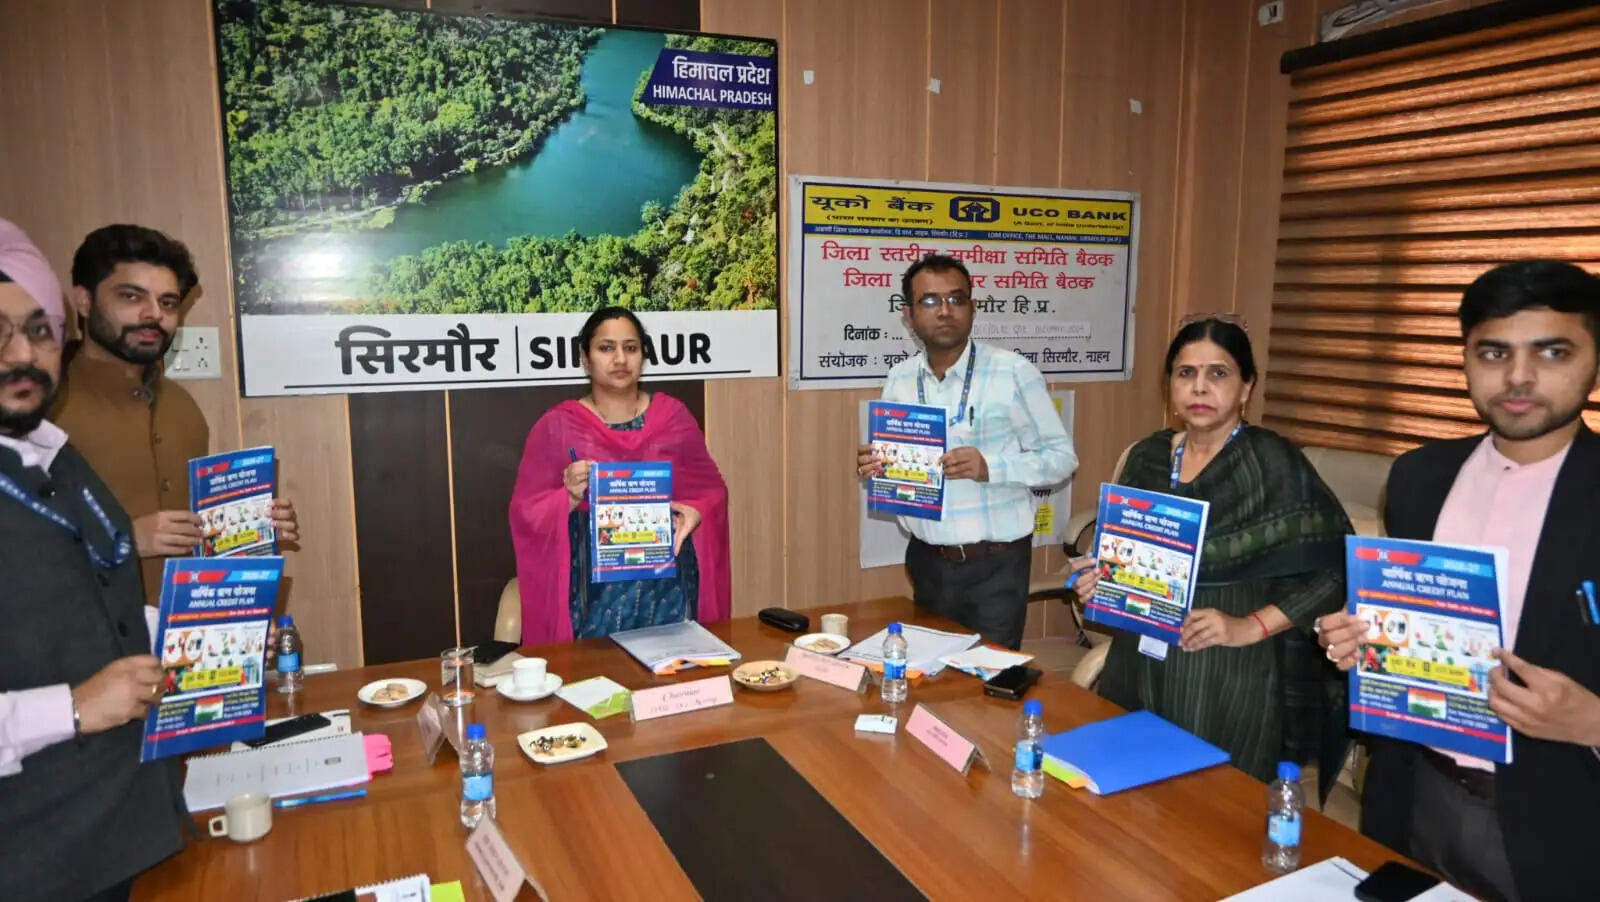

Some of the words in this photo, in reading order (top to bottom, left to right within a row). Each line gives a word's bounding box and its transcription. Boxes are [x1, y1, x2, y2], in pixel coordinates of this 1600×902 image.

[672, 55, 734, 82] हिमाचल
[736, 62, 771, 85] प्रदेश
[653, 84, 717, 102] HIMACHAL
[720, 89, 772, 105] PRADESH
[808, 194, 871, 211] यूको
[887, 196, 935, 212] बैंक
[1012, 207, 1060, 217] UCO
[1067, 209, 1127, 221] BANK
[821, 240, 872, 261] जिला
[946, 245, 1007, 264] समीक्षा
[1014, 246, 1069, 266] समिति
[1076, 248, 1115, 267] बैठक
[843, 267, 892, 287] जिला
[993, 270, 1048, 289] समिति
[1056, 272, 1095, 290] बैठक
[843, 324, 881, 341] दिनांक
[334, 323, 499, 375] सिरमौर
[529, 333, 711, 370] SIAUR
[818, 348, 868, 368] संयोजक
[1043, 347, 1082, 364] सिरमौर,
[1086, 350, 1111, 362] नाहन
[1381, 580, 1416, 593] ANNUAL
[1416, 583, 1446, 597] CREDIT
[1446, 587, 1470, 601] PLAN
